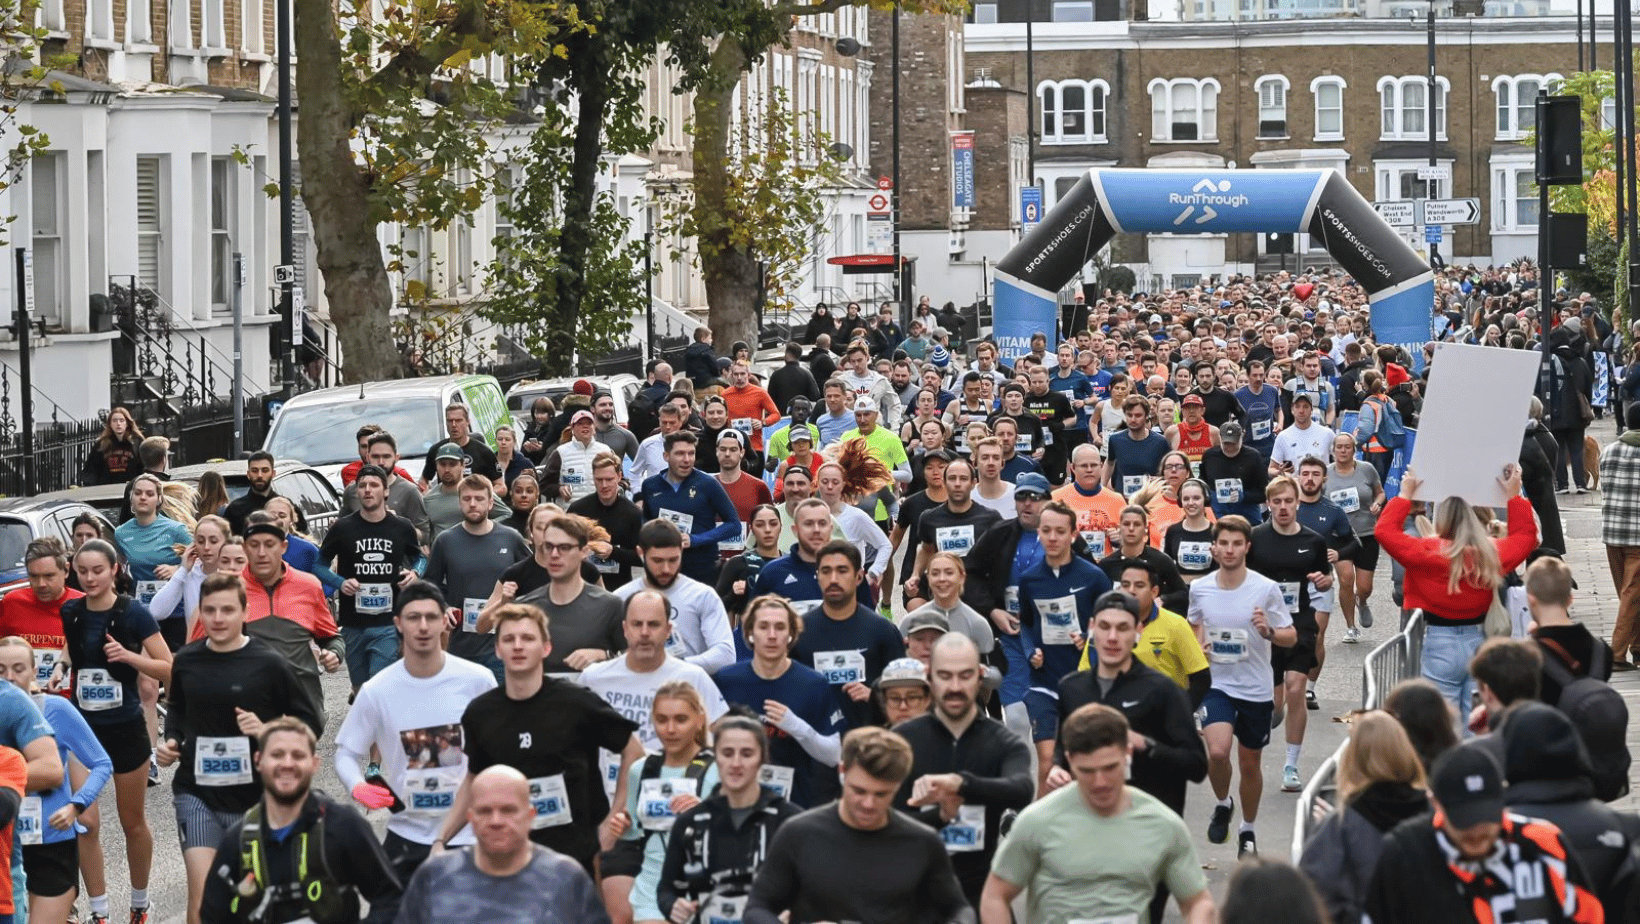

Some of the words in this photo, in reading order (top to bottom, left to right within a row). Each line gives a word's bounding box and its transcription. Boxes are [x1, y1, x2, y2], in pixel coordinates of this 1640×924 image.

[955, 160, 963, 195] STUDIOS
[963, 151, 972, 204] CHELSEAGATE
[1169, 192, 1248, 208] RunThrough
[1025, 204, 1093, 273] SPORTSSHOES.COM
[1323, 209, 1391, 279] SPORTSSHOES.COM
[996, 336, 1031, 348] VITAM
[355, 538, 393, 553] NIKE
[943, 539, 968, 550] 1863
[355, 563, 393, 575] TOKYO
[363, 597, 385, 606] 2117
[20, 634, 66, 645] ERPENTI
[825, 670, 857, 681] 1649
[82, 685, 114, 700] 3605
[606, 691, 654, 708] SPRAN
[203, 759, 241, 773] 3283
[414, 794, 451, 808] 2312
[535, 800, 557, 814] 28
[942, 828, 972, 842] 174
